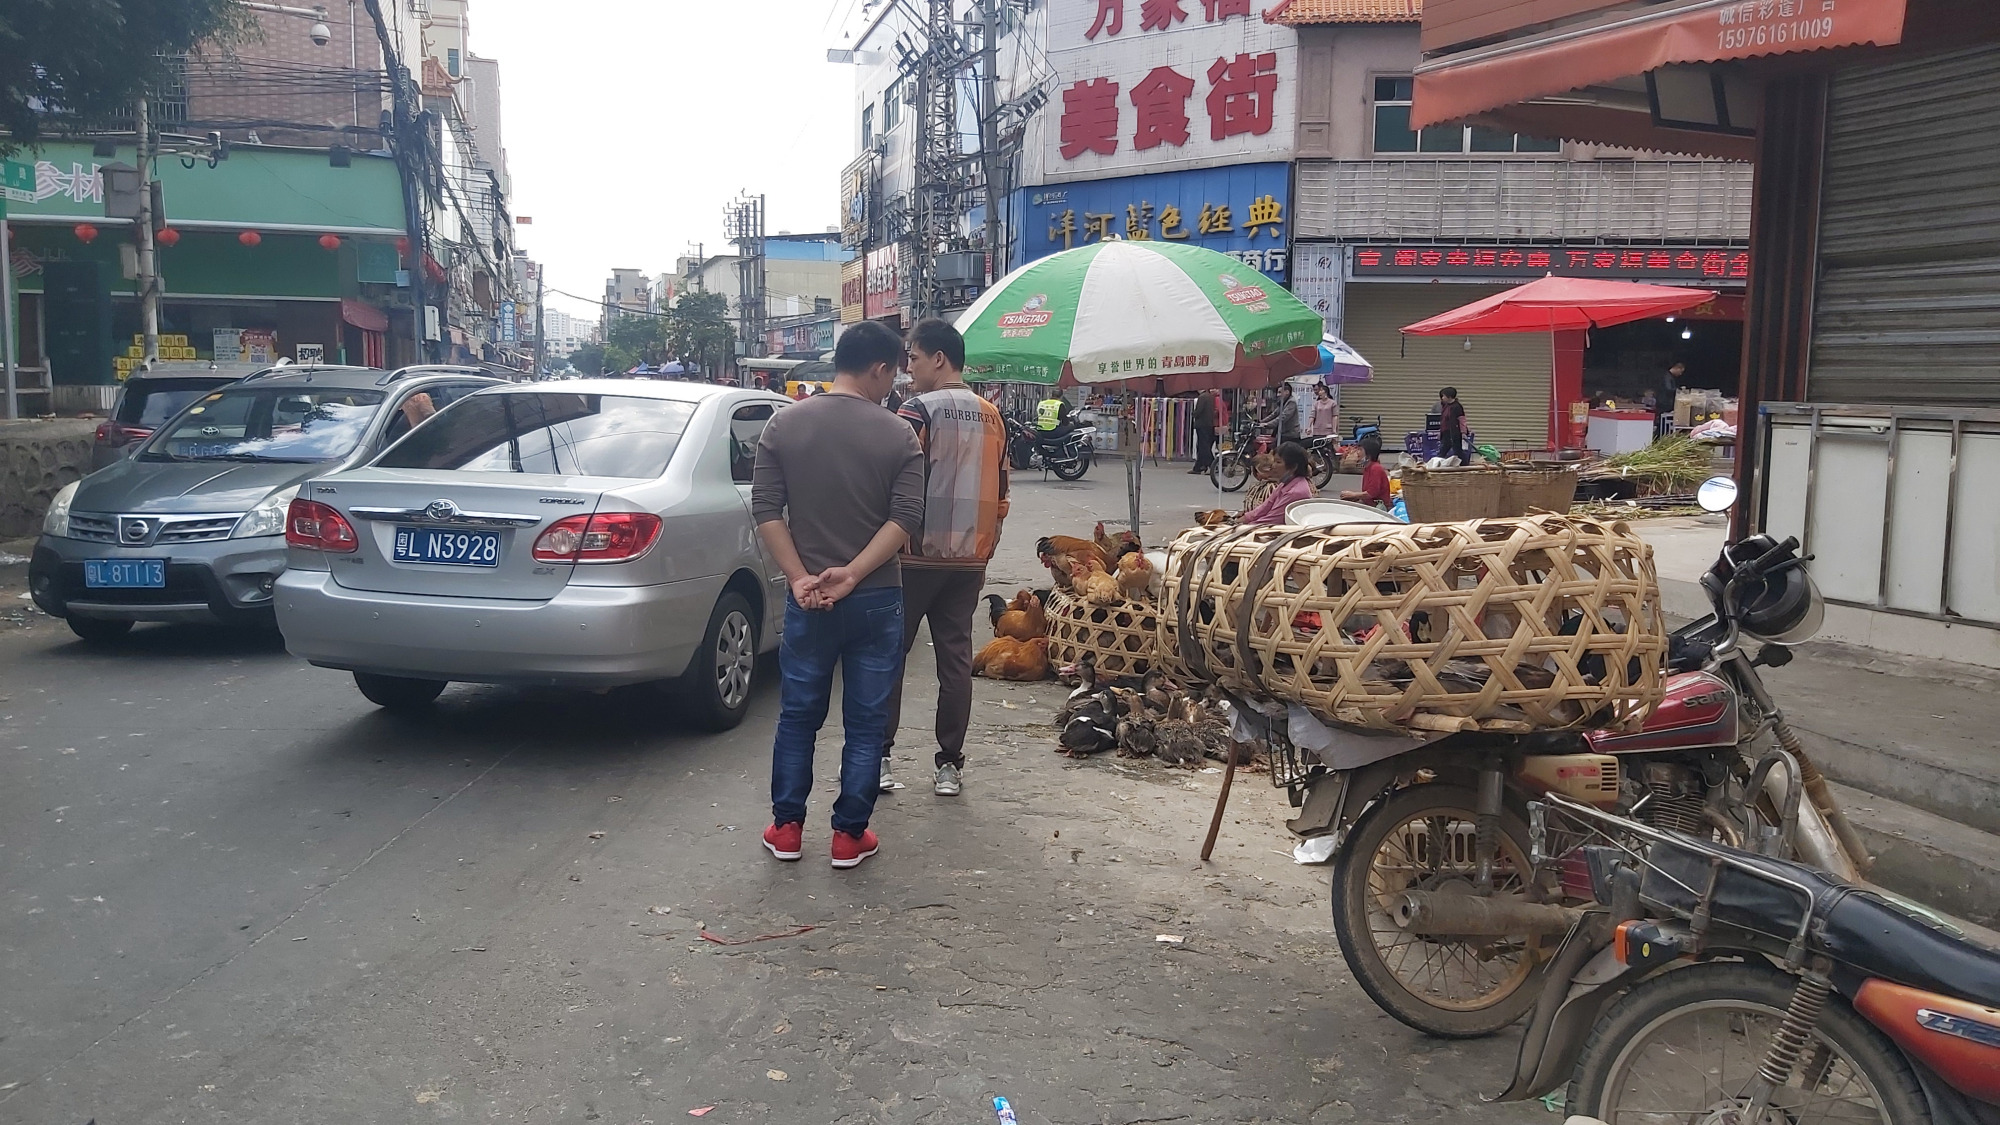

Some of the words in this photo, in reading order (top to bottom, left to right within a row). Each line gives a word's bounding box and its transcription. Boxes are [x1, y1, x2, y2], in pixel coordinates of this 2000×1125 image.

[1717, 16, 1833, 50] 15976161009
[1060, 52, 1277, 160] 美食街
[1227, 288, 1263, 303] TSINGTAO
[1003, 313, 1049, 325] TSINGTAO
[135, 335, 188, 347] 本有售
[297, 347, 324, 365] 招聘
[944, 408, 996, 425] BURBERRY
[539, 496, 585, 505] COROLLA
[428, 533, 497, 561] N3928
